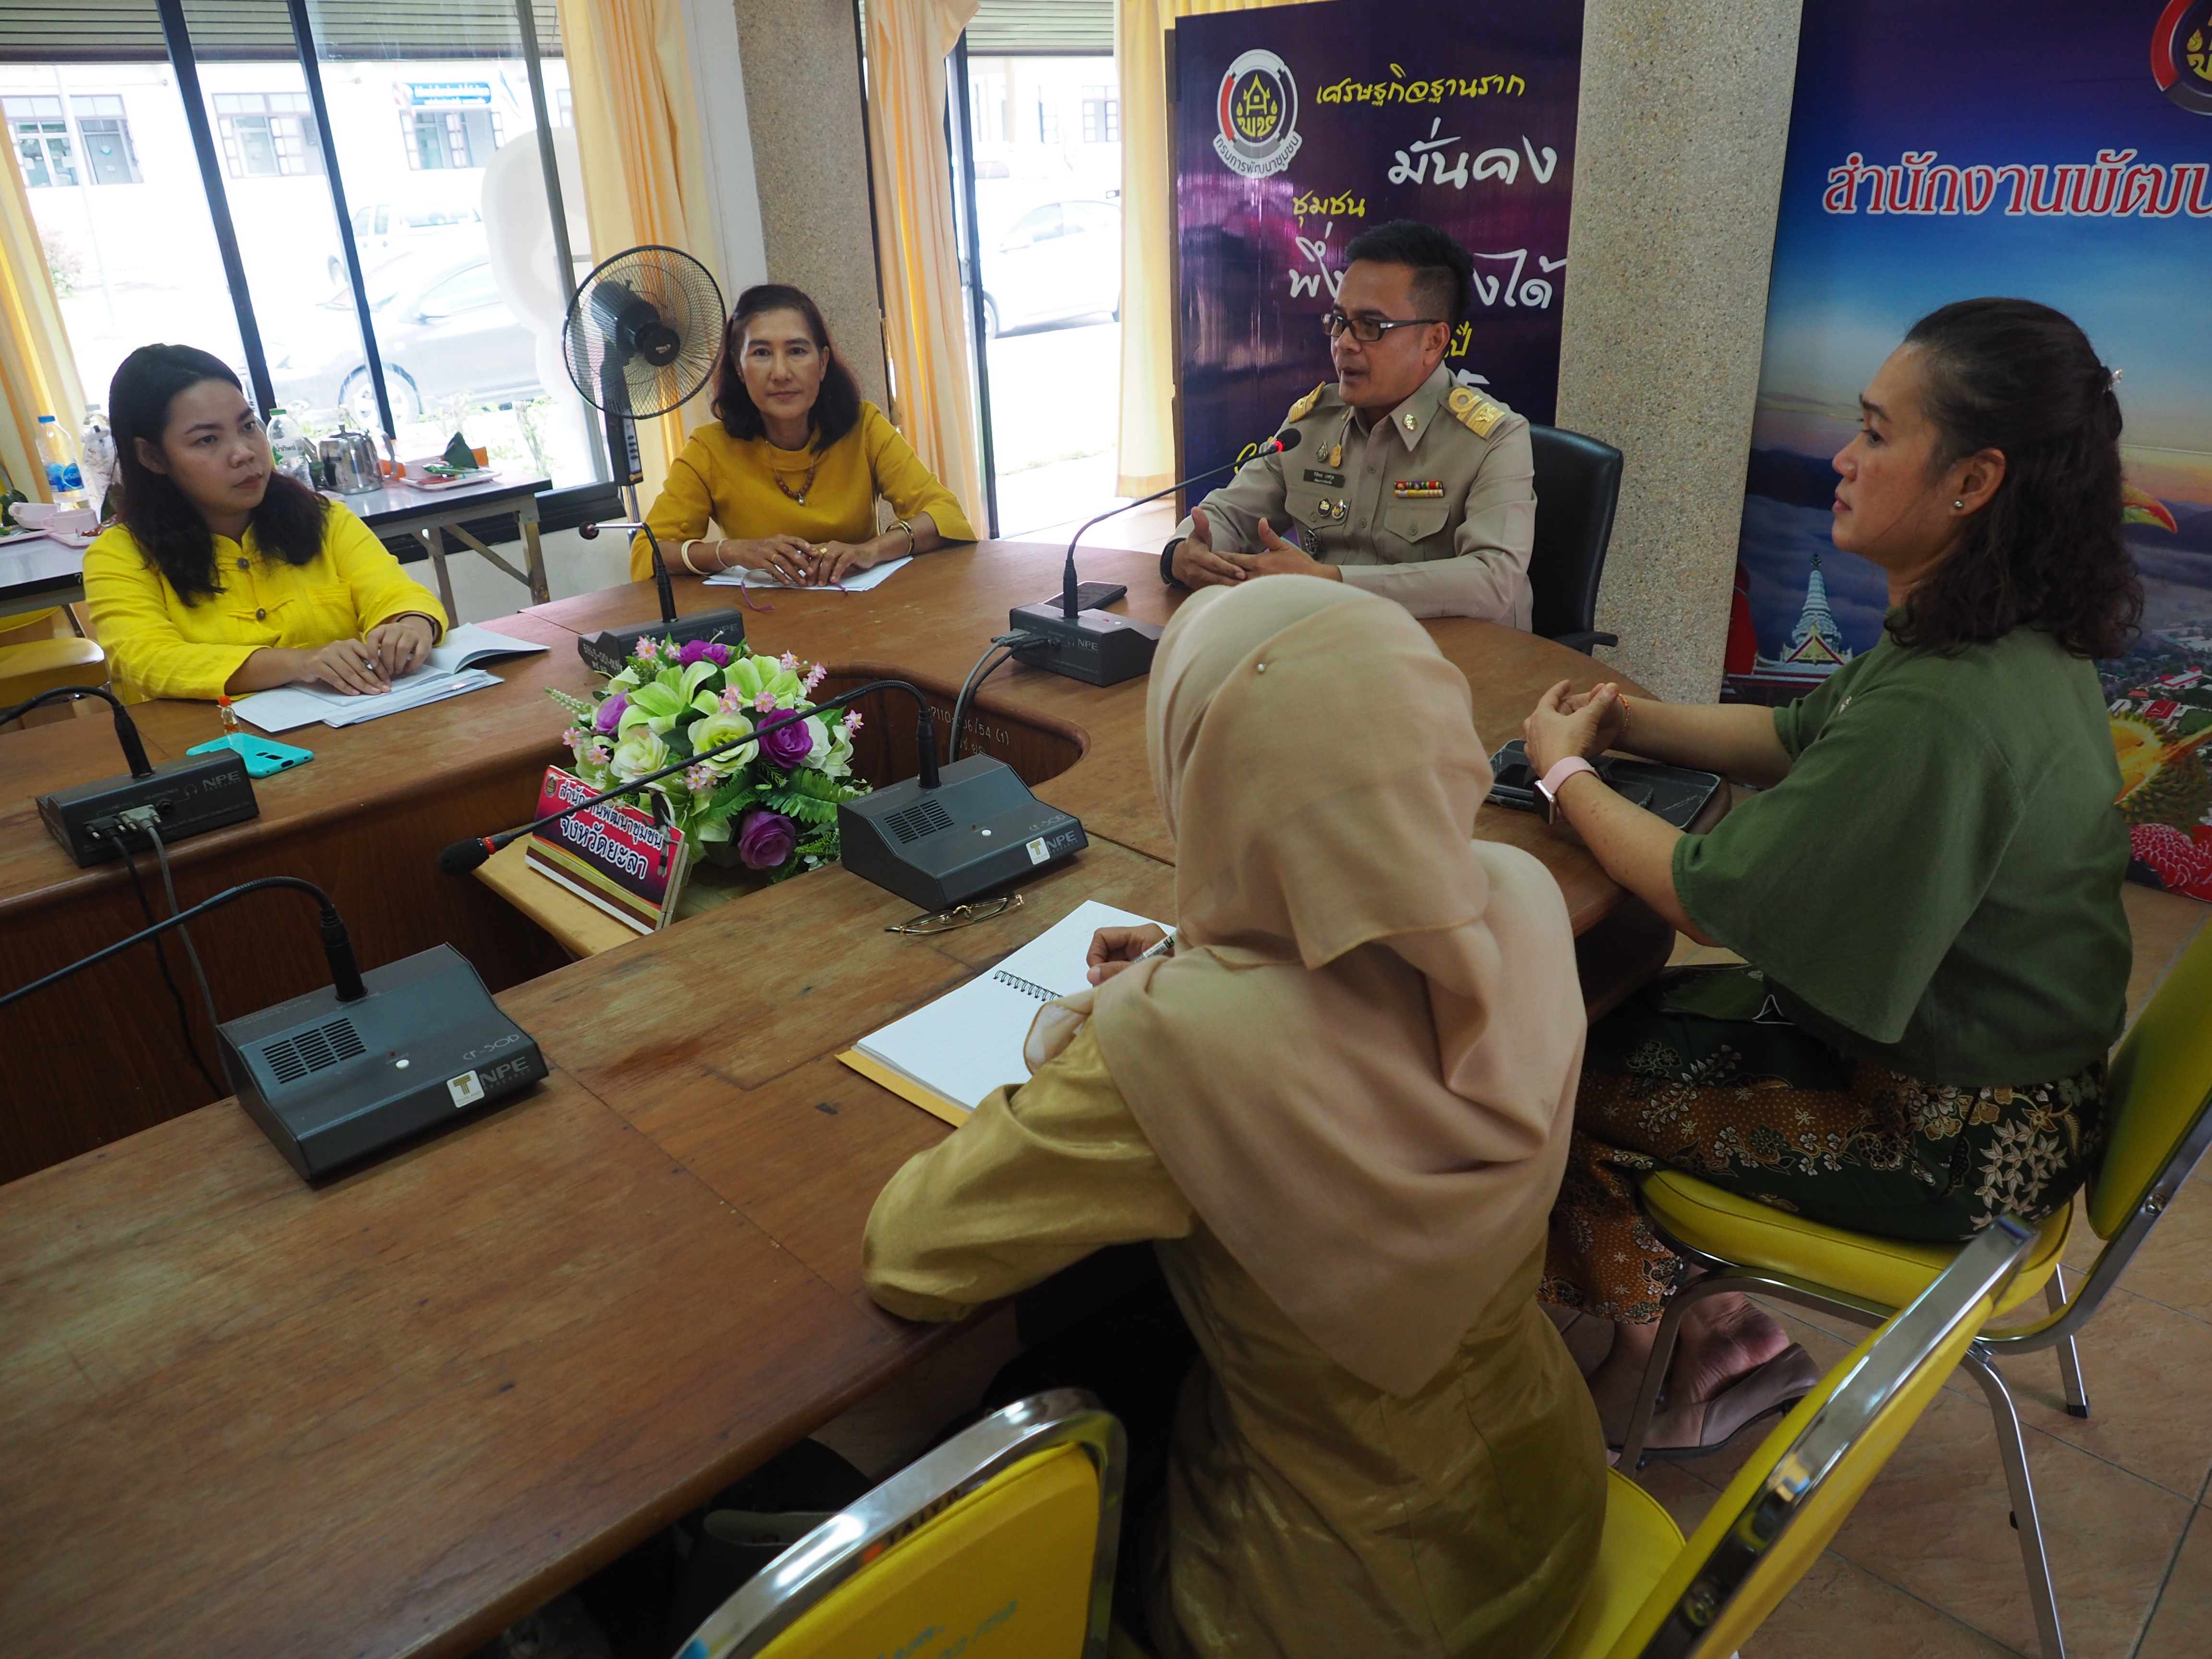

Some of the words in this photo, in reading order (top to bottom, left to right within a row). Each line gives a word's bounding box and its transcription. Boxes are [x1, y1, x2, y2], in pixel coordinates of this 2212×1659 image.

[1316, 63, 1526, 106] เศรษฐกิจฐานราก
[1215, 134, 1299, 174] กรมการพัฒนาชุมชน
[1387, 117, 1558, 189] มั่นคง
[1292, 189, 1366, 228] ชุมชน
[1078, 638, 1098, 651] NPE
[202, 770, 240, 788] NPE
[1046, 830, 1077, 850] NPE
[479, 1056, 529, 1086] NPE
